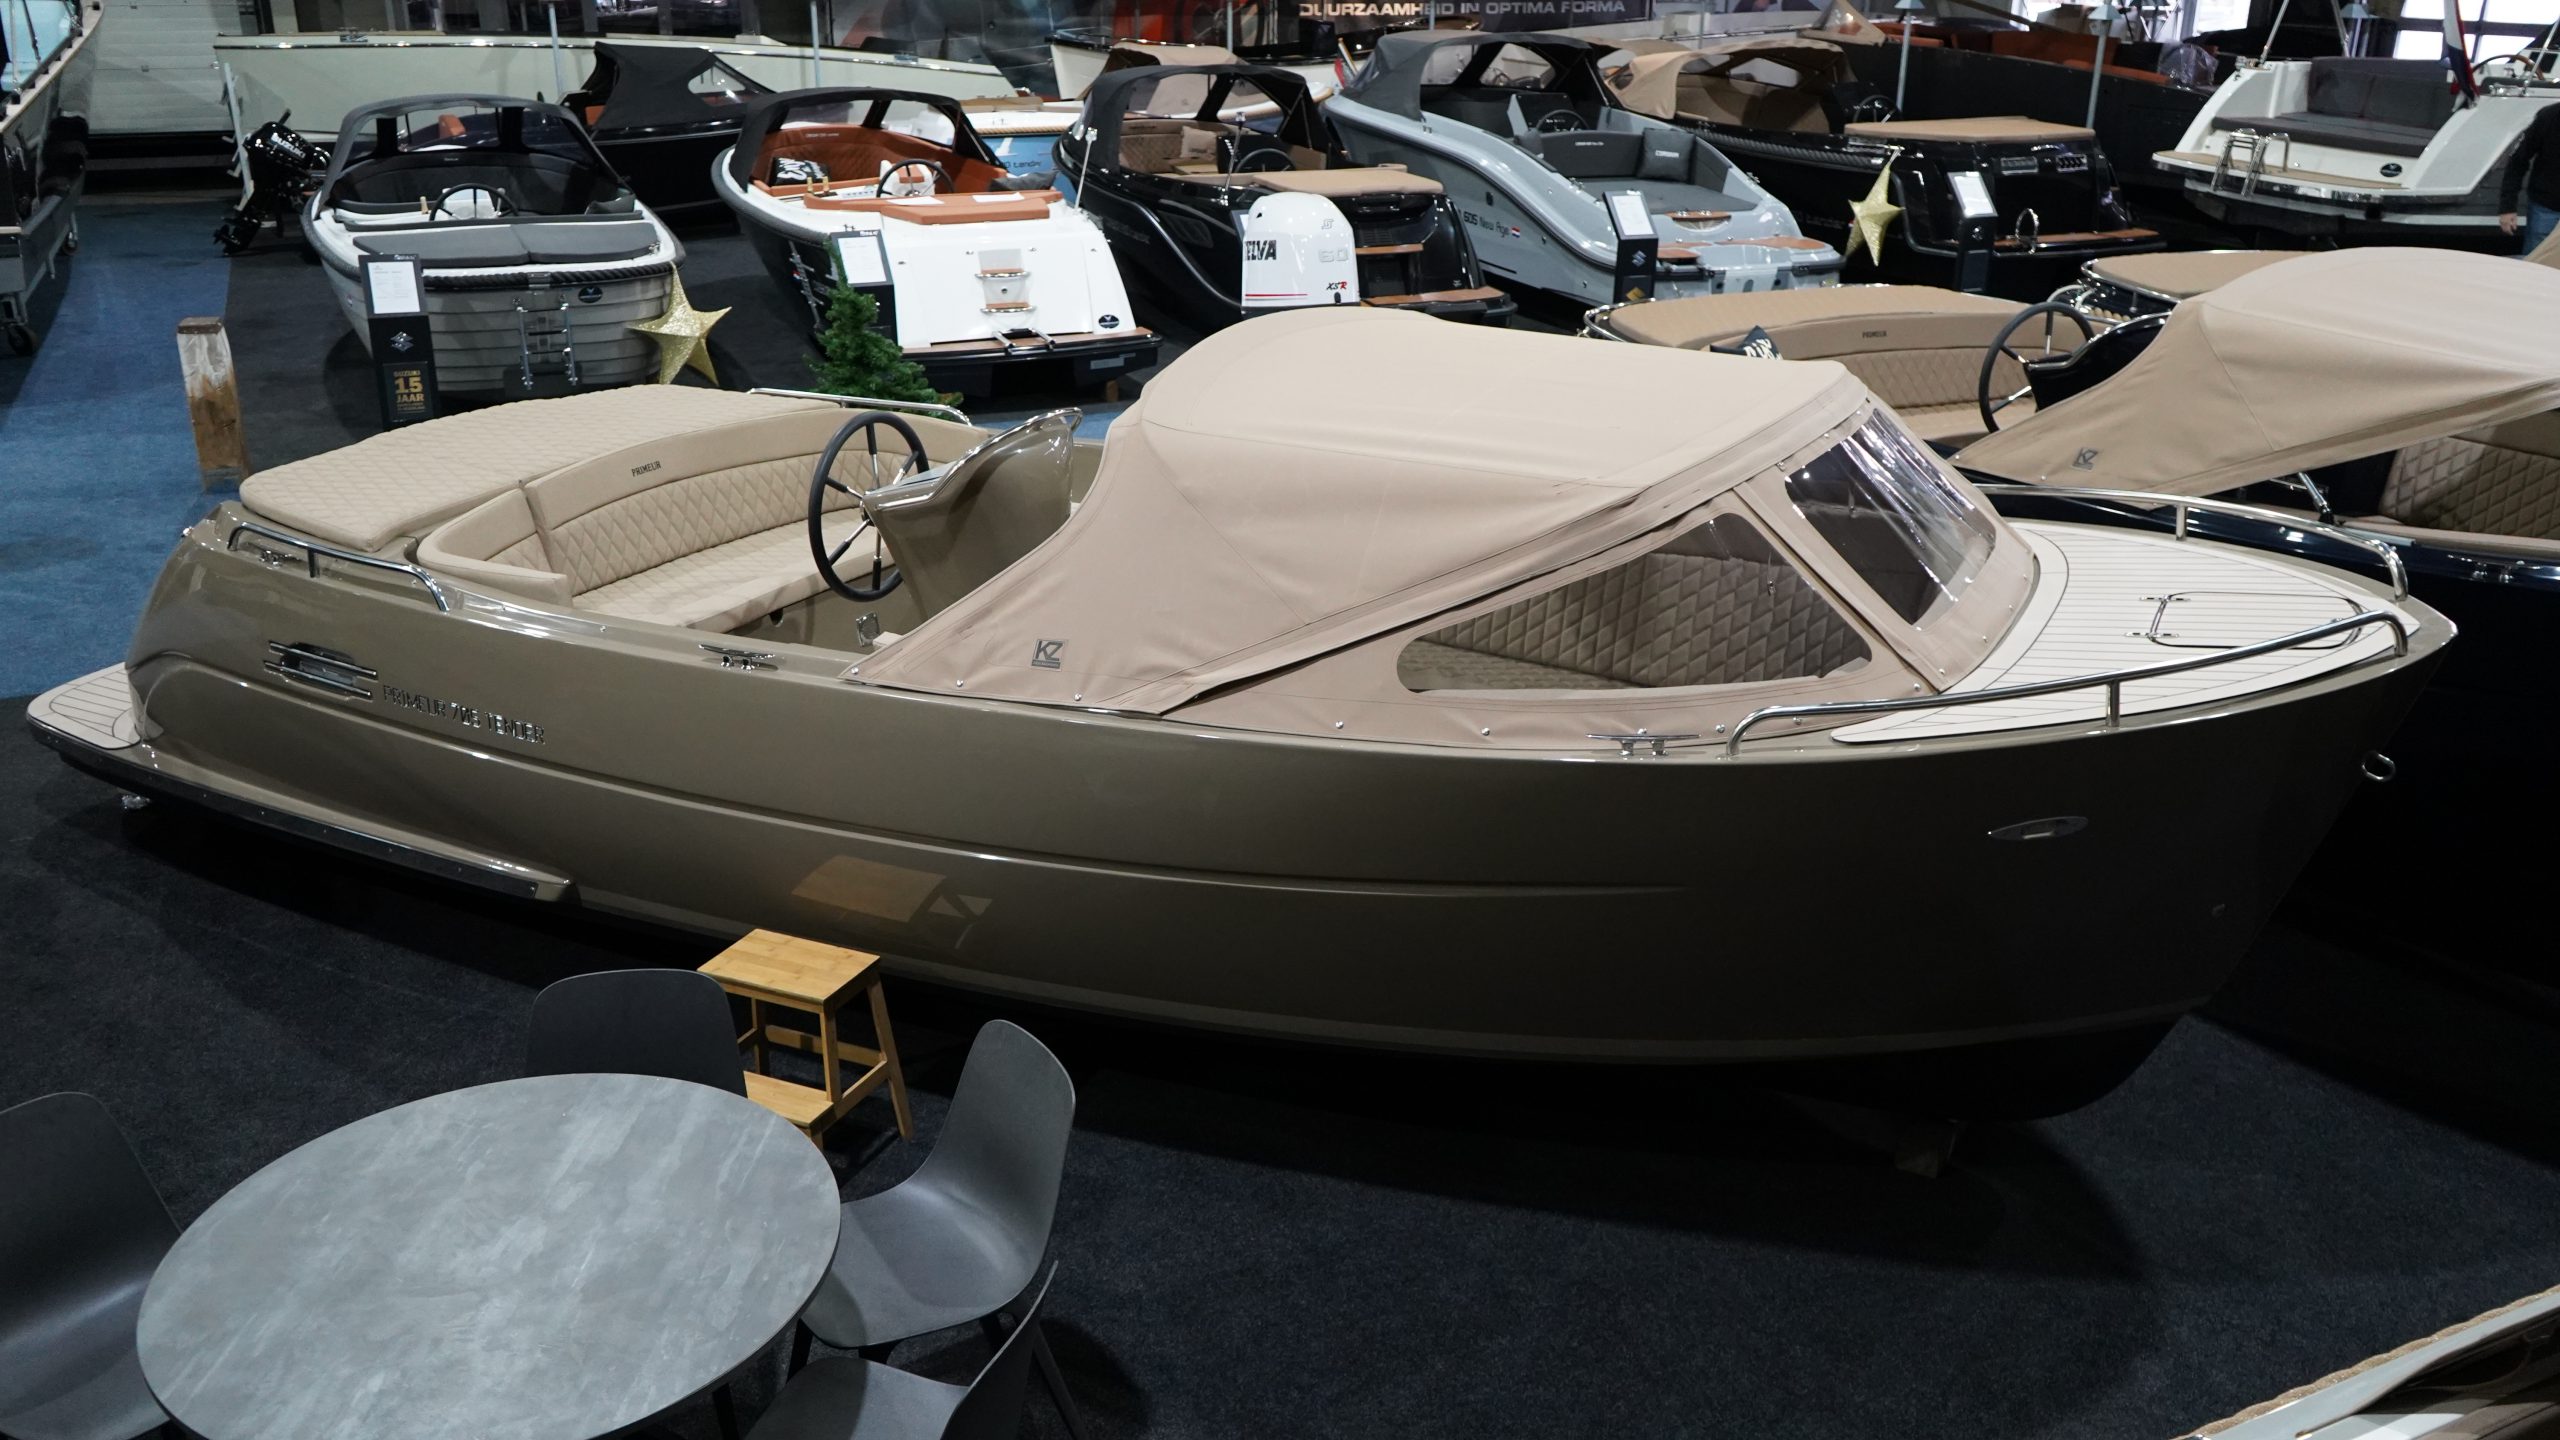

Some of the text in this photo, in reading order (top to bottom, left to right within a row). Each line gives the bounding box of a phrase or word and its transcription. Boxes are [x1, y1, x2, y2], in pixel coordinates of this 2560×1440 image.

[1299, 1, 1626, 17] DUURZAAMHEID IN OPTIMA FORMA
[271, 132, 306, 159] SUZUKI
[1326, 281, 1348, 291] XSR
[394, 376, 423, 394] 15
[396, 393, 425, 403] JAAR
[631, 460, 662, 477] PRIMEUR
[383, 685, 545, 745] PRIMEUR 705 TENDER
